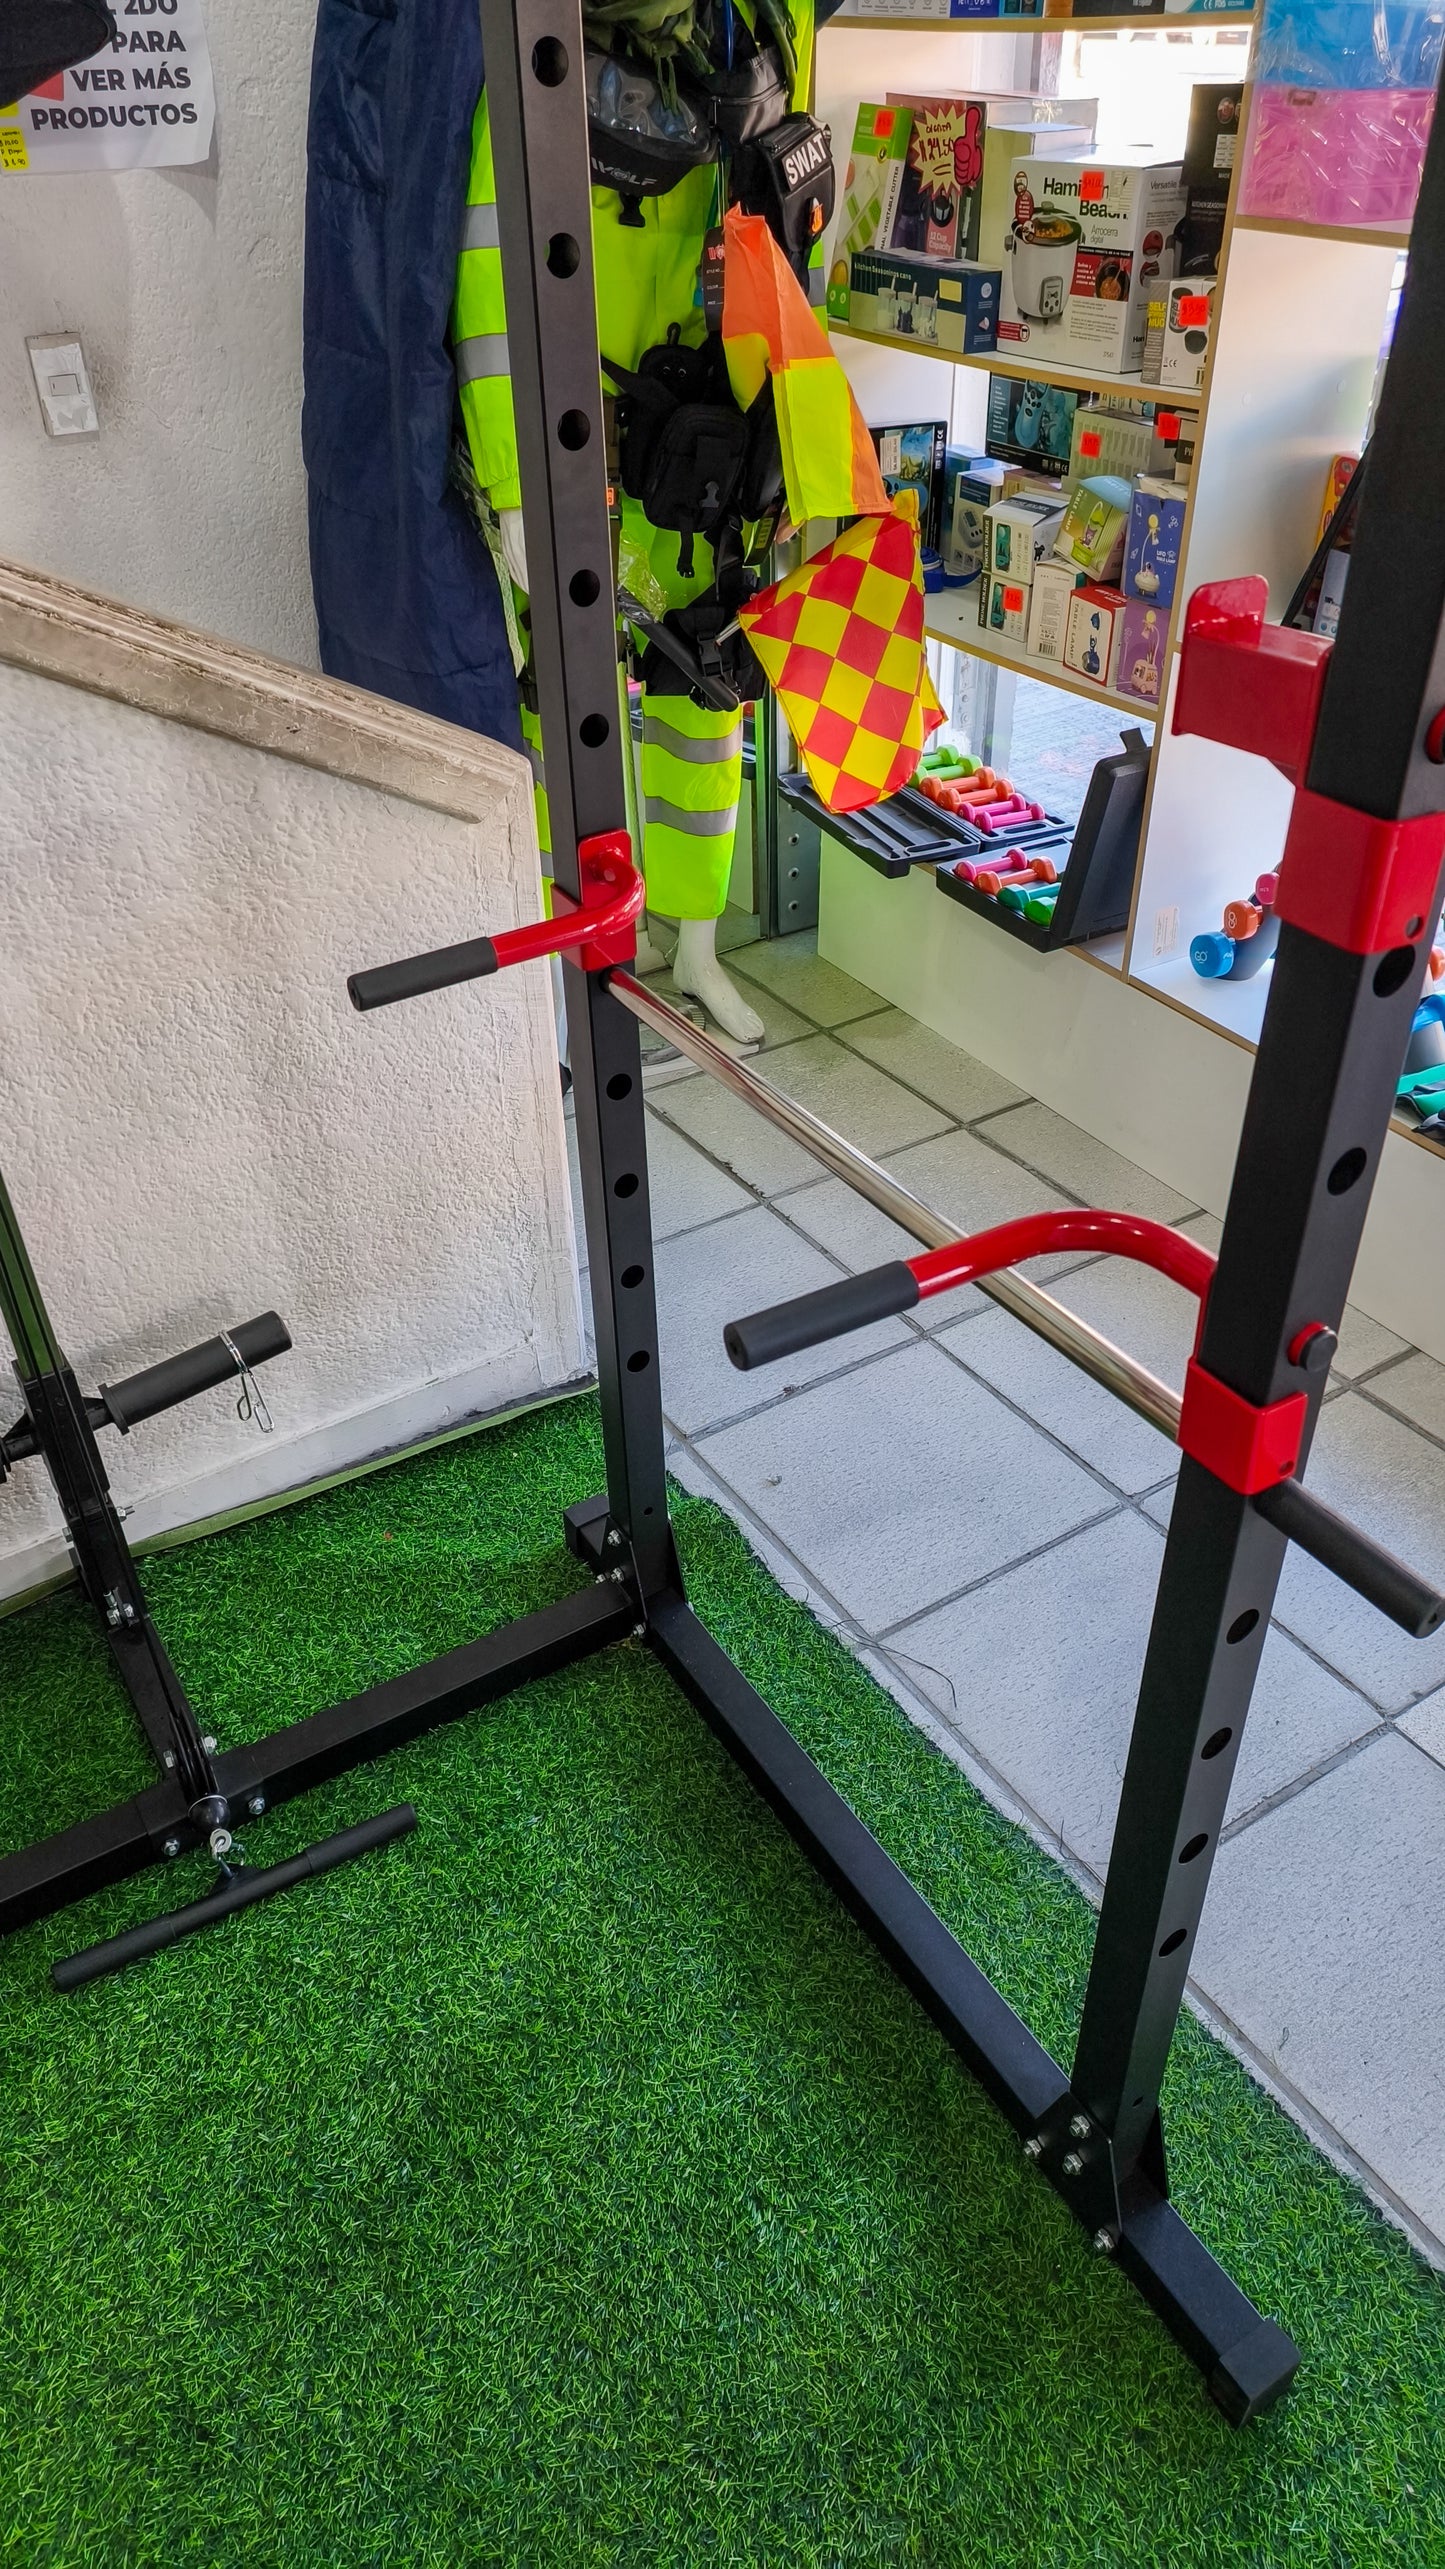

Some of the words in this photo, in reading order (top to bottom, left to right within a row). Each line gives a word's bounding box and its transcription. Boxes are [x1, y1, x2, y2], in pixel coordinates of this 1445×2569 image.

[111, 30, 187, 53] PARA
[70, 69, 127, 92] VER
[132, 61, 192, 90] MÁS
[31, 103, 198, 131] PRODUCTOS
[785, 132, 827, 185] SWAT
[1043, 177, 1109, 199] Hamin
[1150, 181, 1178, 191] Versatile
[883, 195, 895, 233] VEGETABLE
[890, 166, 900, 193] CUTTER
[1079, 199, 1127, 220] Bea
[928, 240, 951, 253] Capacity
[936, 232, 948, 244] Cup
[1149, 301, 1167, 311] SELF
[1148, 318, 1165, 328] MUG
[1072, 488, 1084, 510] TABLE
[1065, 510, 1075, 531] LAMP
[1072, 603, 1080, 630] TABLE
[1194, 951, 1208, 962] GO
